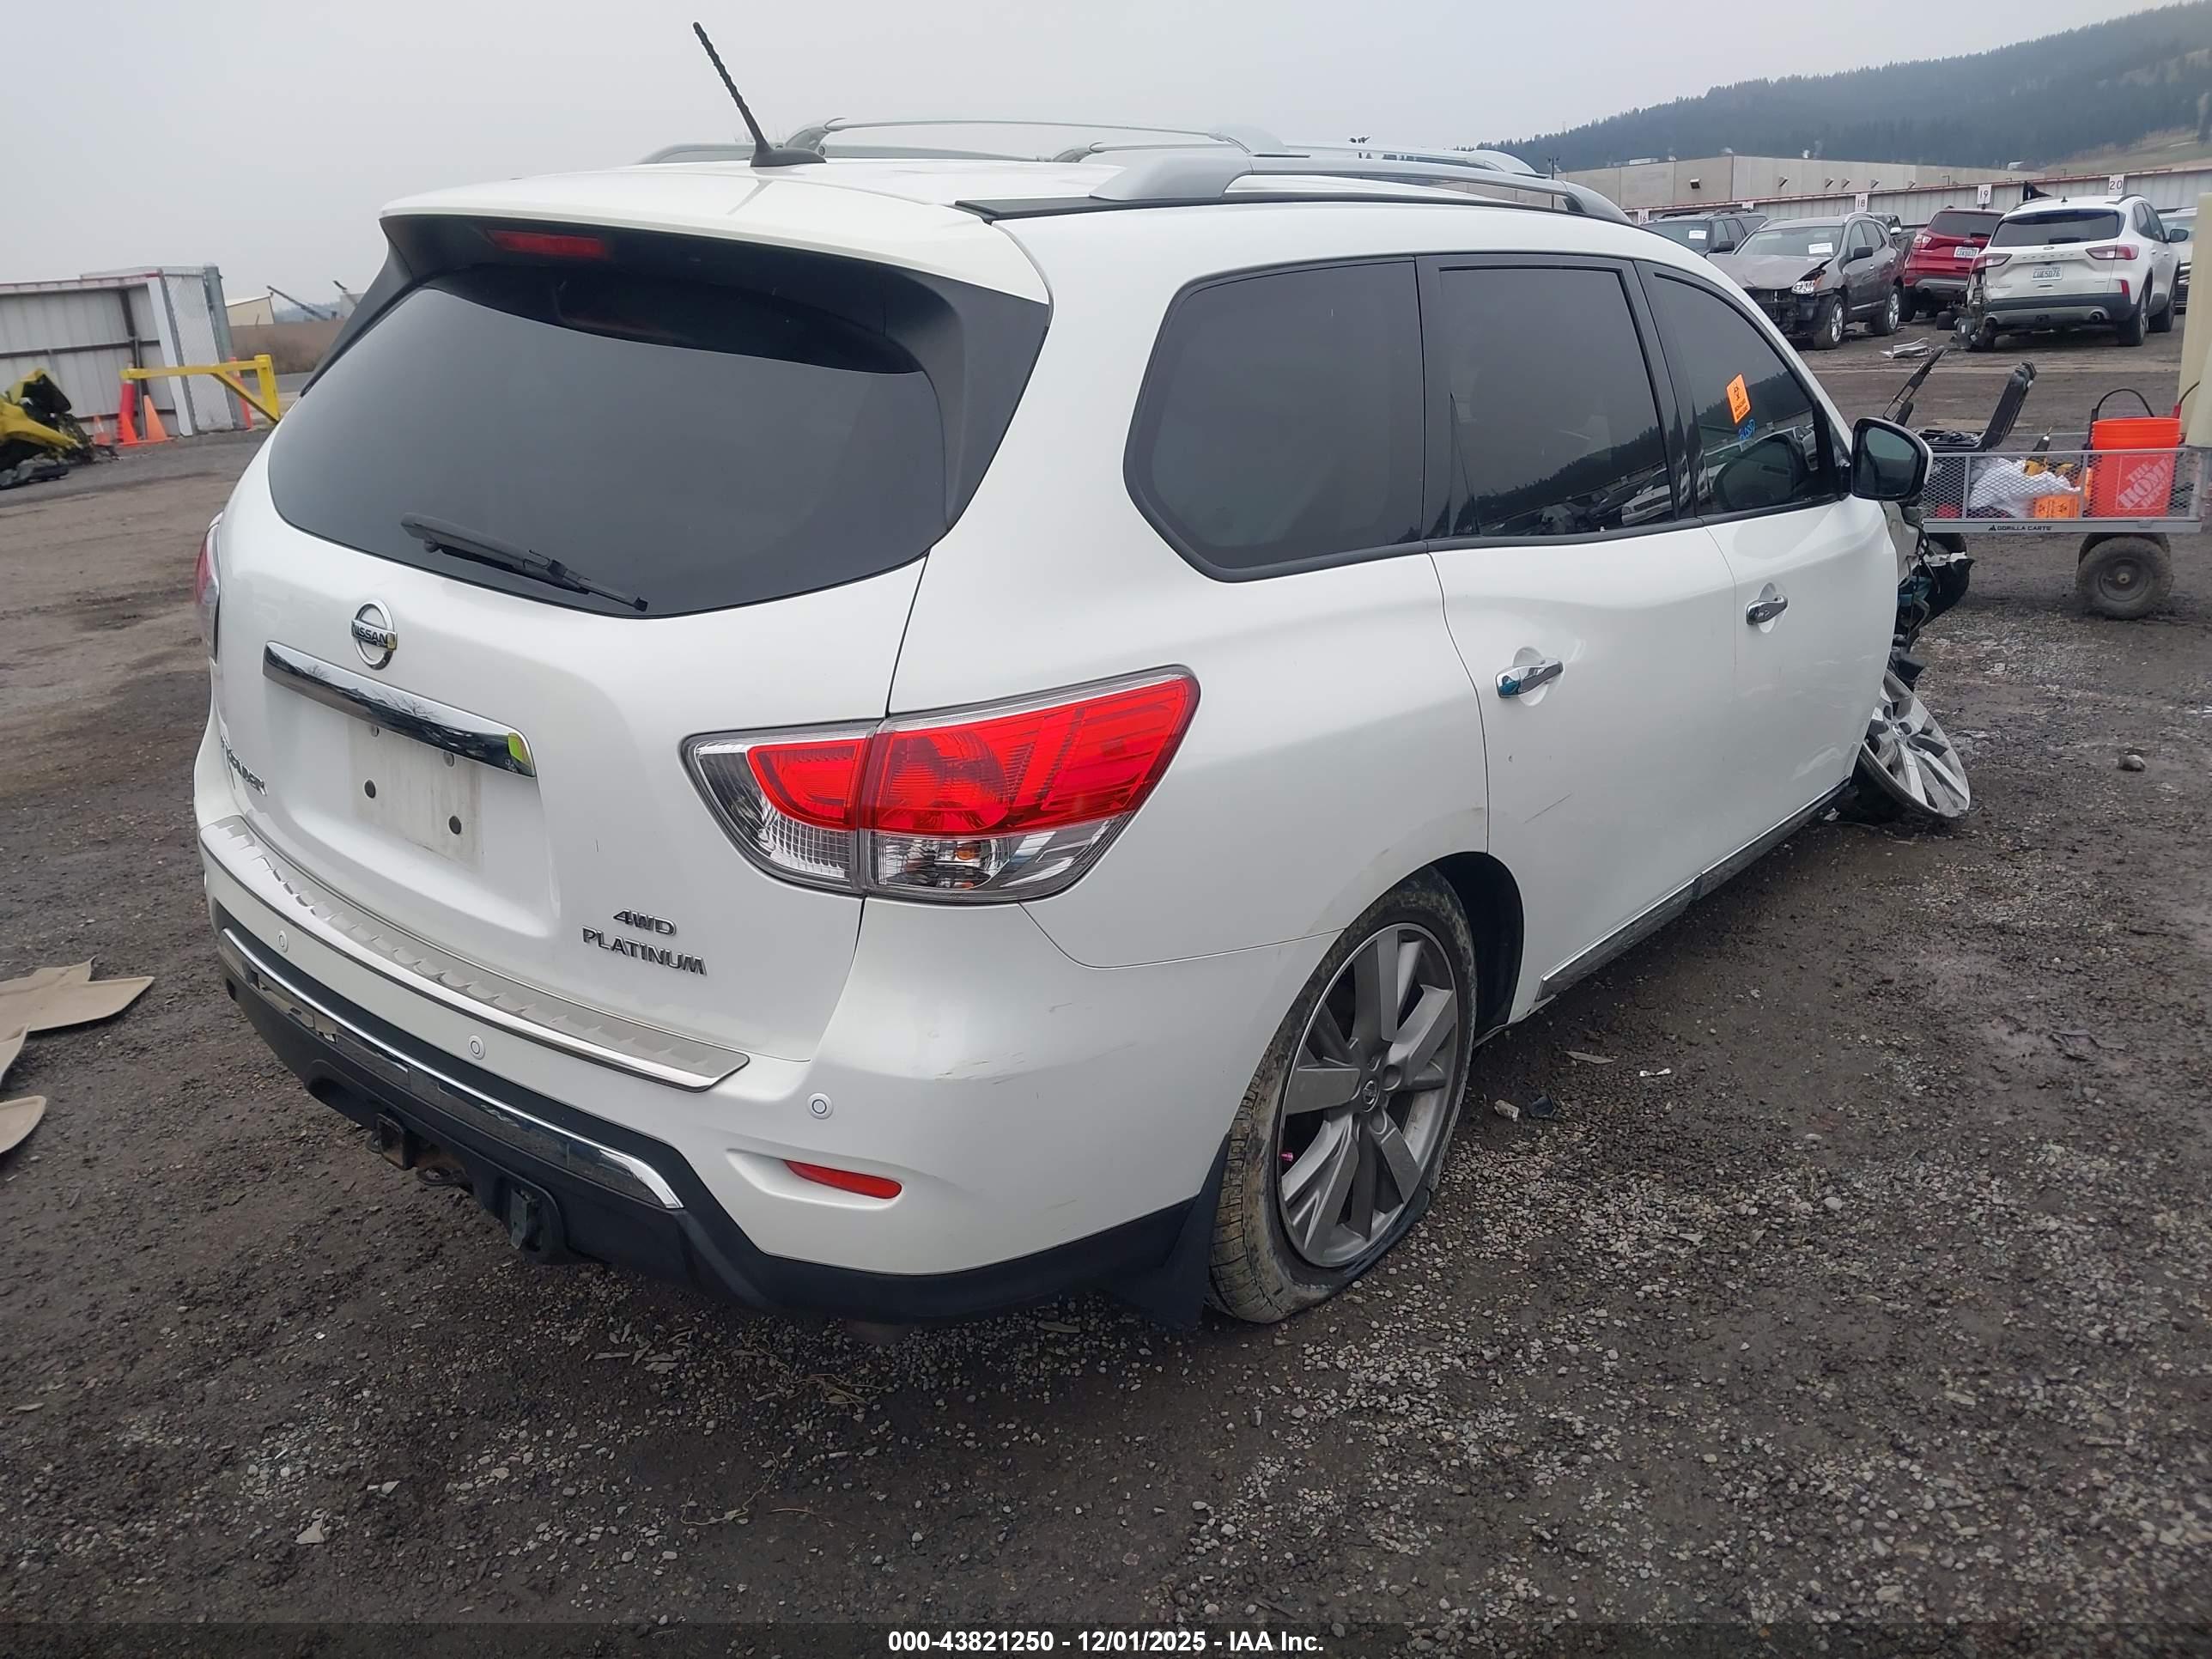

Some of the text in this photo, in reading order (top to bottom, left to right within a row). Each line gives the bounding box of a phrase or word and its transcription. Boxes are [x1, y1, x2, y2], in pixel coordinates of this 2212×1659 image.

[2109, 179, 2123, 191] 20
[1856, 198, 1865, 208] 18
[1979, 190, 1989, 199] 19
[352, 623, 387, 645] NISSAN
[612, 908, 677, 936] 4WD
[582, 926, 708, 976] PLATINUM
